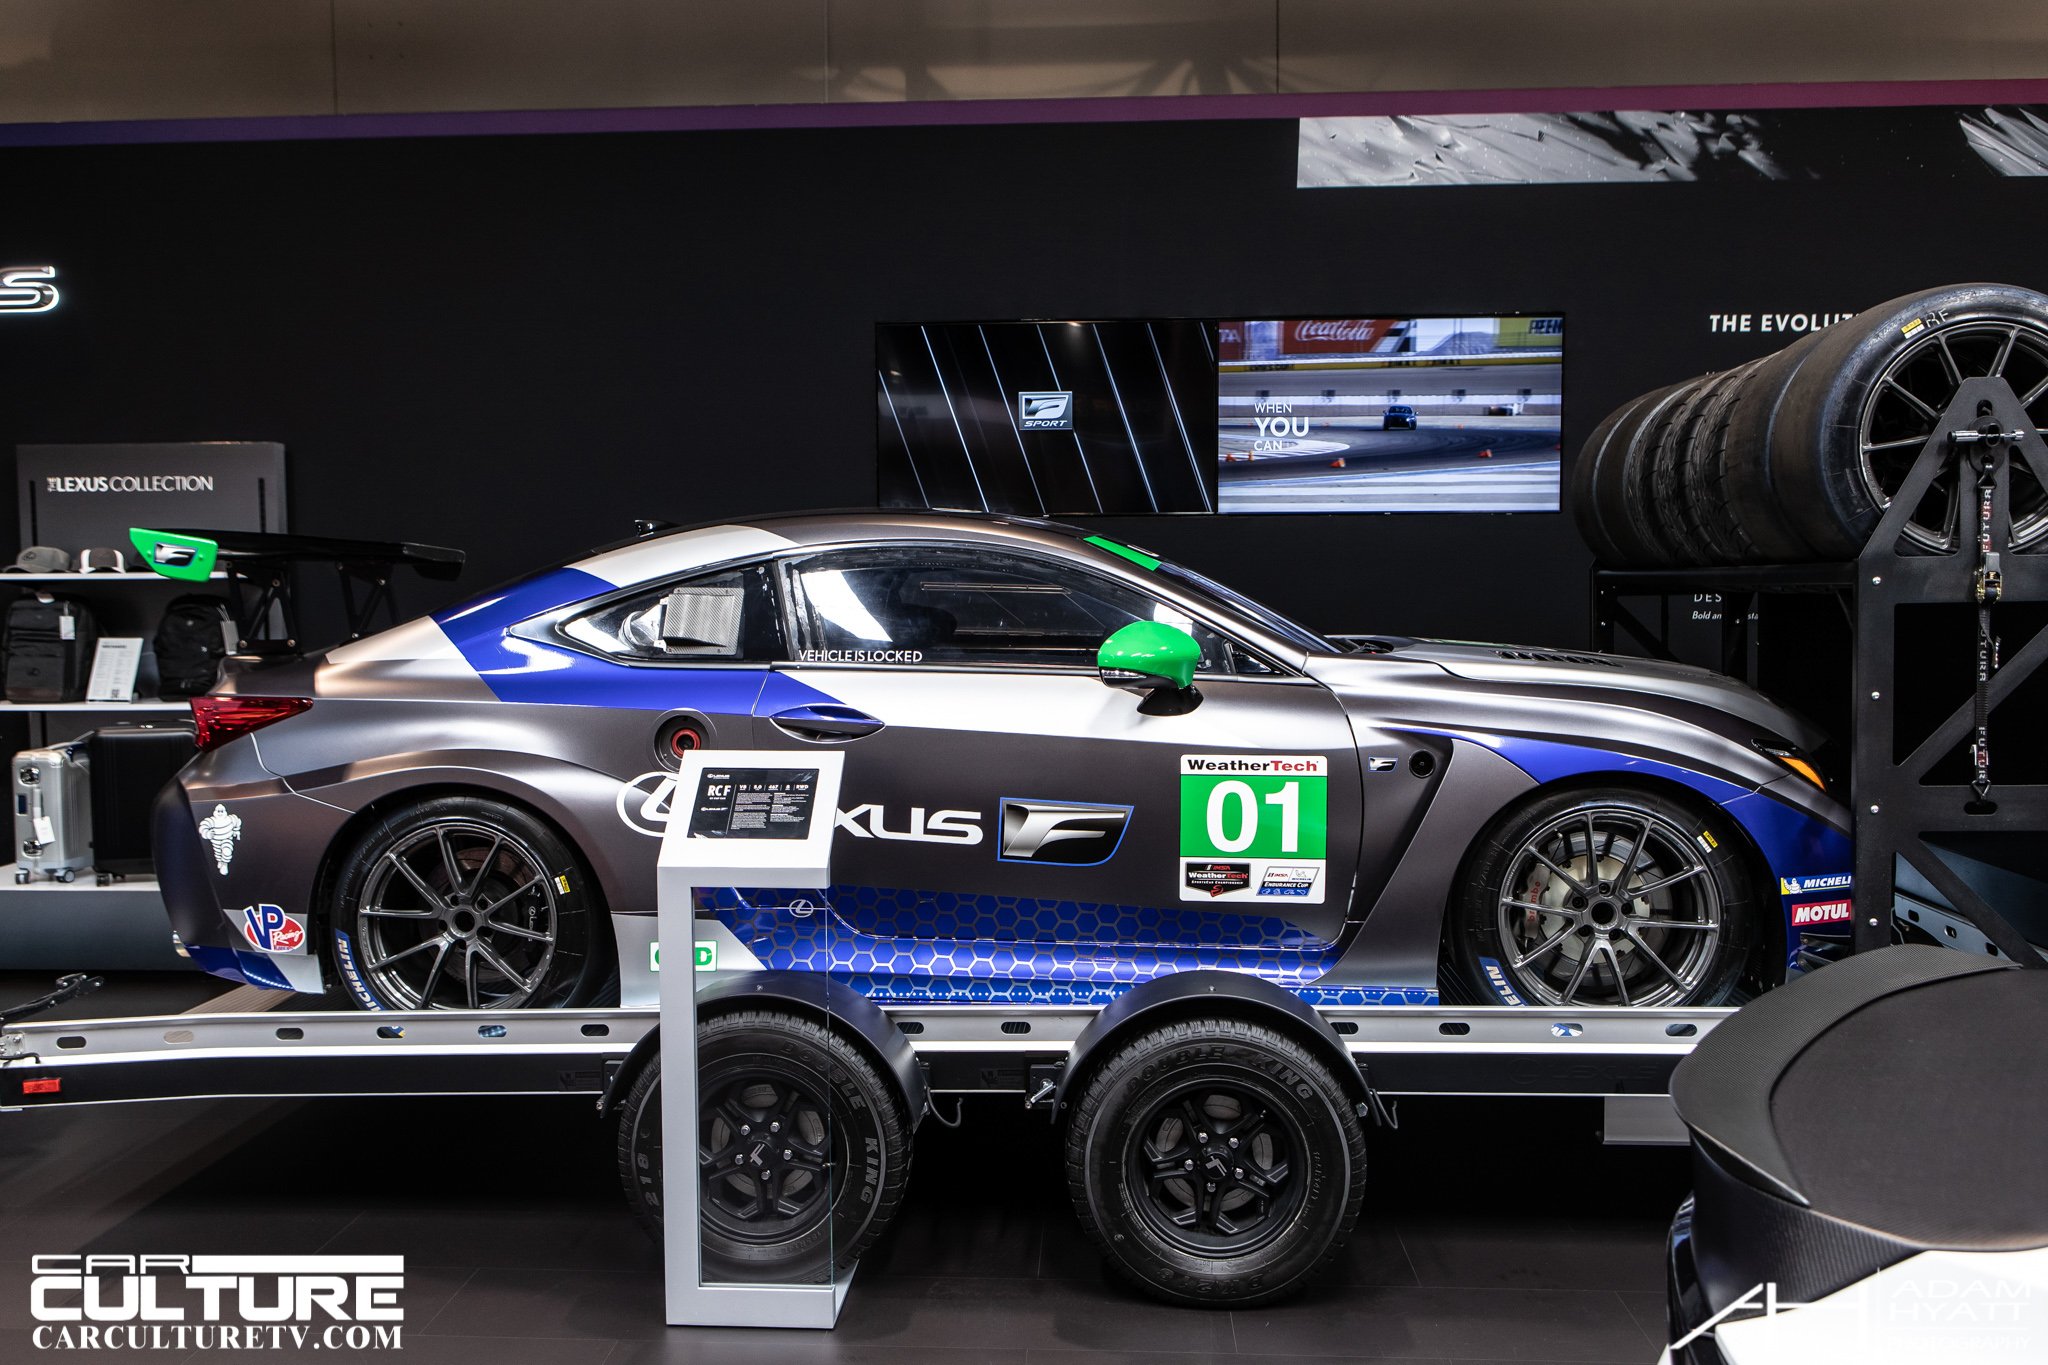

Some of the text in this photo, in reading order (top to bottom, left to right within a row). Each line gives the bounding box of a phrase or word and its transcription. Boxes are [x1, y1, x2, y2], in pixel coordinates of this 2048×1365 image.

[1709, 313, 1858, 333] THE EVOLUT
[1254, 402, 1292, 414] WHEN
[1255, 417, 1310, 437] YOU
[1254, 440, 1283, 451] CAN
[56, 476, 108, 492] LEXUS
[109, 475, 214, 492] COLLECTION
[1692, 611, 1712, 620] Bold
[799, 650, 923, 662] VEHICLE IS LOCKED
[1188, 758, 1318, 773] WeatherTech
[708, 785, 732, 796] RC F
[1206, 780, 1299, 853] 01
[1528, 881, 1541, 923] brmbo
[1794, 903, 1849, 923] MOTUL
[243, 904, 285, 952] VP
[273, 929, 304, 946] Racing
[1251, 1053, 1315, 1101] KING
[859, 1136, 880, 1203] KING
